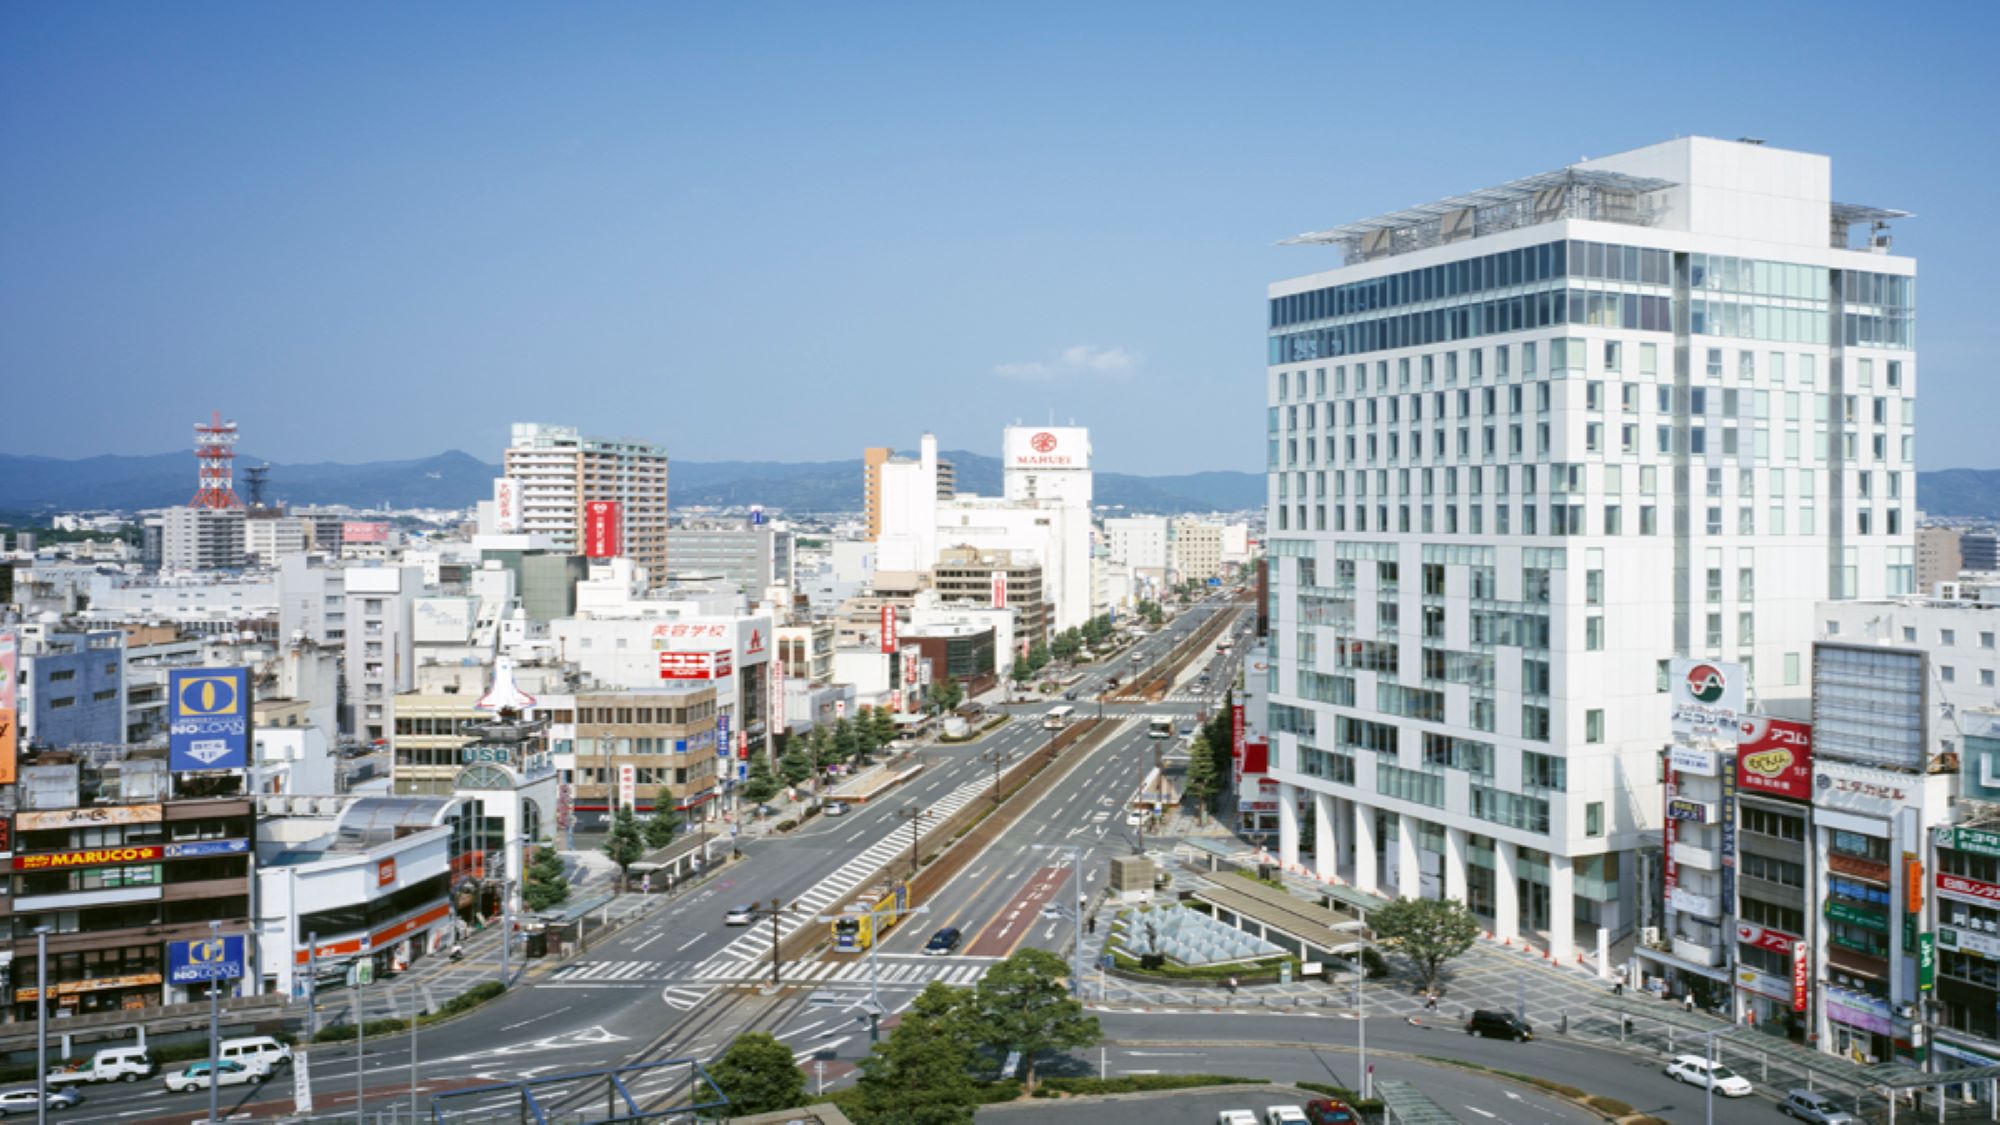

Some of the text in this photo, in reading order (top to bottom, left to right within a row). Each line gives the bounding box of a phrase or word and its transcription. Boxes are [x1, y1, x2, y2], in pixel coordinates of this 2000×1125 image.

[1770, 728, 1809, 745] アコム
[463, 746, 510, 762] USA
[51, 849, 138, 867] MARUCO
